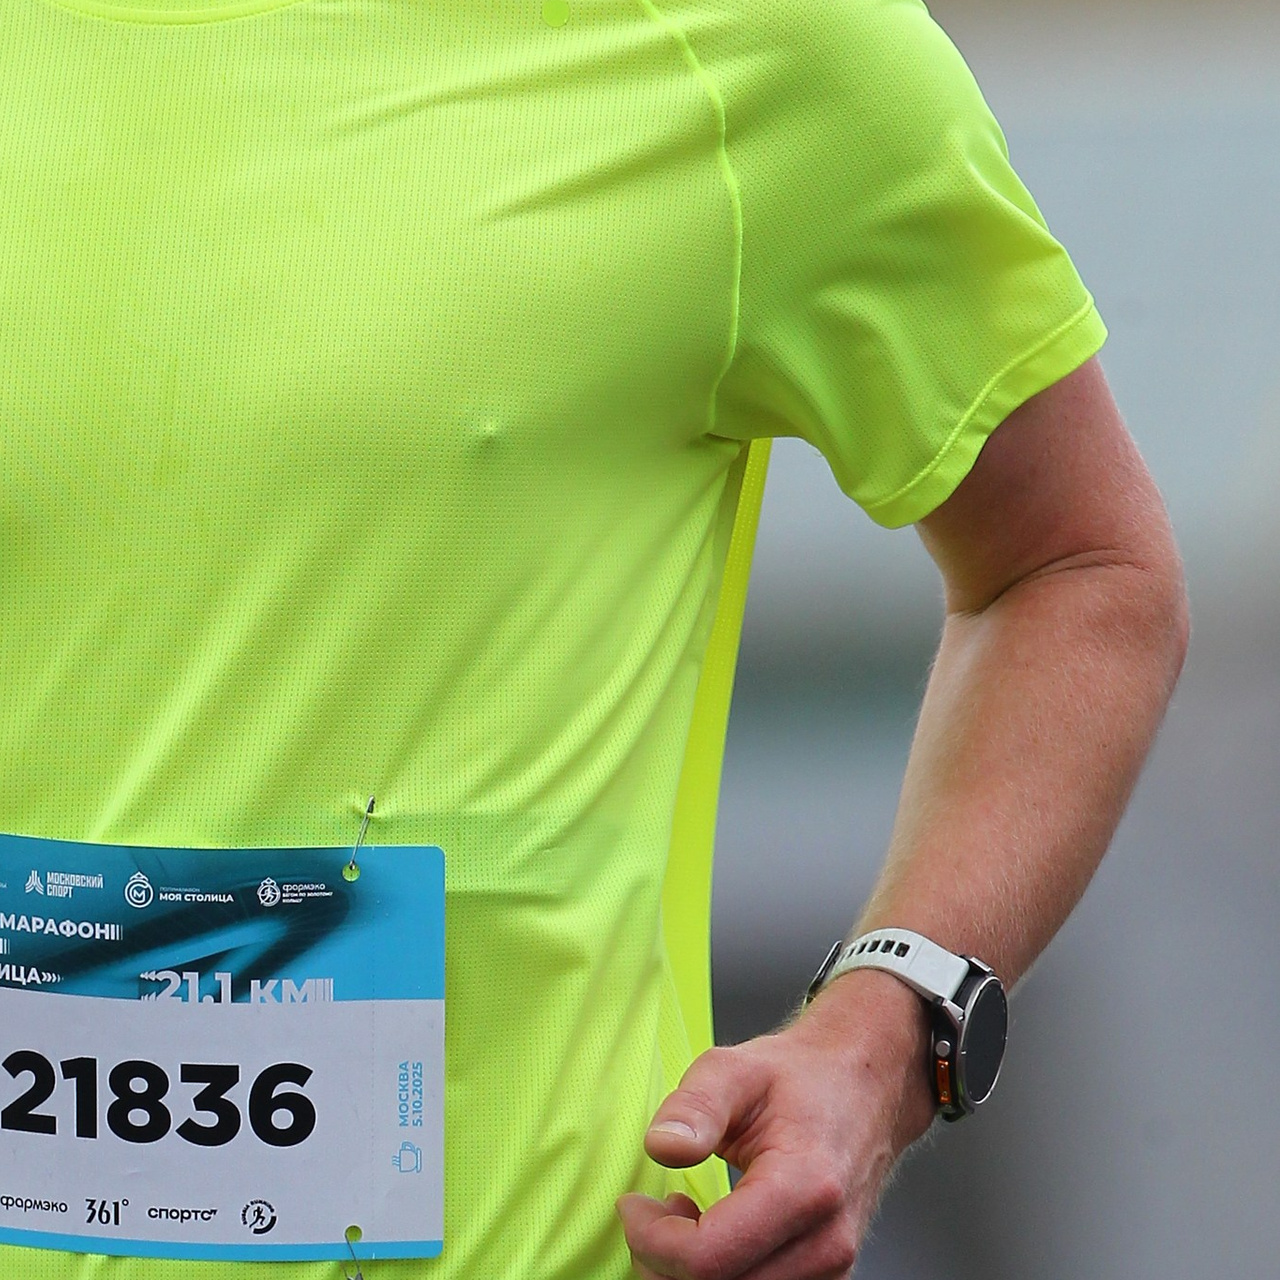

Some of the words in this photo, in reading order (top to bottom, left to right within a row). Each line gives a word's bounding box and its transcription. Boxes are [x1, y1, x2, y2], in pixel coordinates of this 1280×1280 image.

[46, 871, 104, 889] МОСКОВСКИЙ
[46, 885, 73, 898] СПОРТ
[159, 893, 182, 901] МОЯ
[184, 893, 234, 903] СТОЛИЦА
[154, 970, 232, 1003] 21.1
[0, 1050, 317, 1147] 21836
[399, 1060, 409, 1127] МОСКВА
[412, 1061, 423, 1127] 5.10.2025
